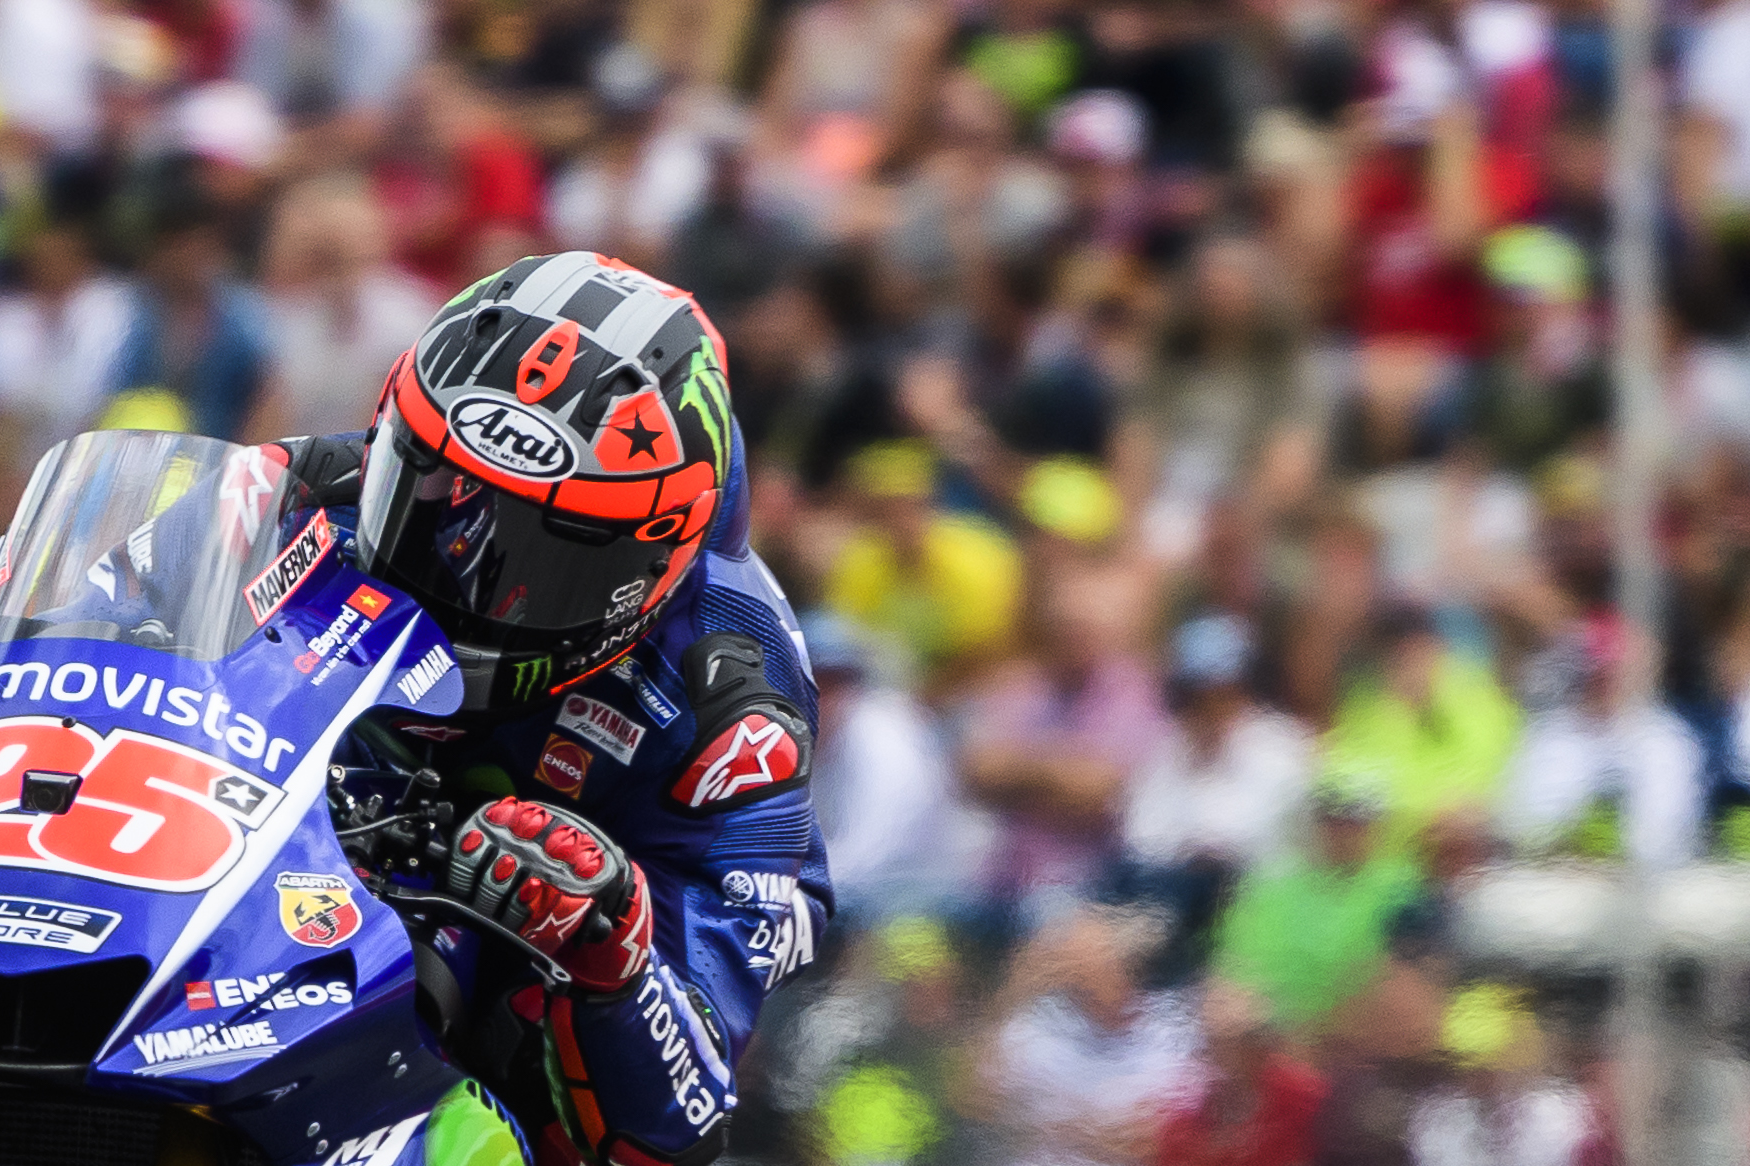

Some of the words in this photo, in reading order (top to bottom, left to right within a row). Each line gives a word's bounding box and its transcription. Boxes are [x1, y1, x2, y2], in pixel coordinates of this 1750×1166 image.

[453, 408, 563, 467] Arai
[478, 441, 523, 468] HELMET
[251, 526, 321, 619] MAVERICK
[308, 604, 360, 657] Beyond
[397, 645, 456, 705] YAMAHA
[589, 702, 640, 749] YAMAHA
[543, 753, 584, 781] ENEOS
[279, 876, 344, 889] ABARTH
[214, 971, 353, 1014] ENEOS
[134, 1019, 278, 1064] YAMALUBE
